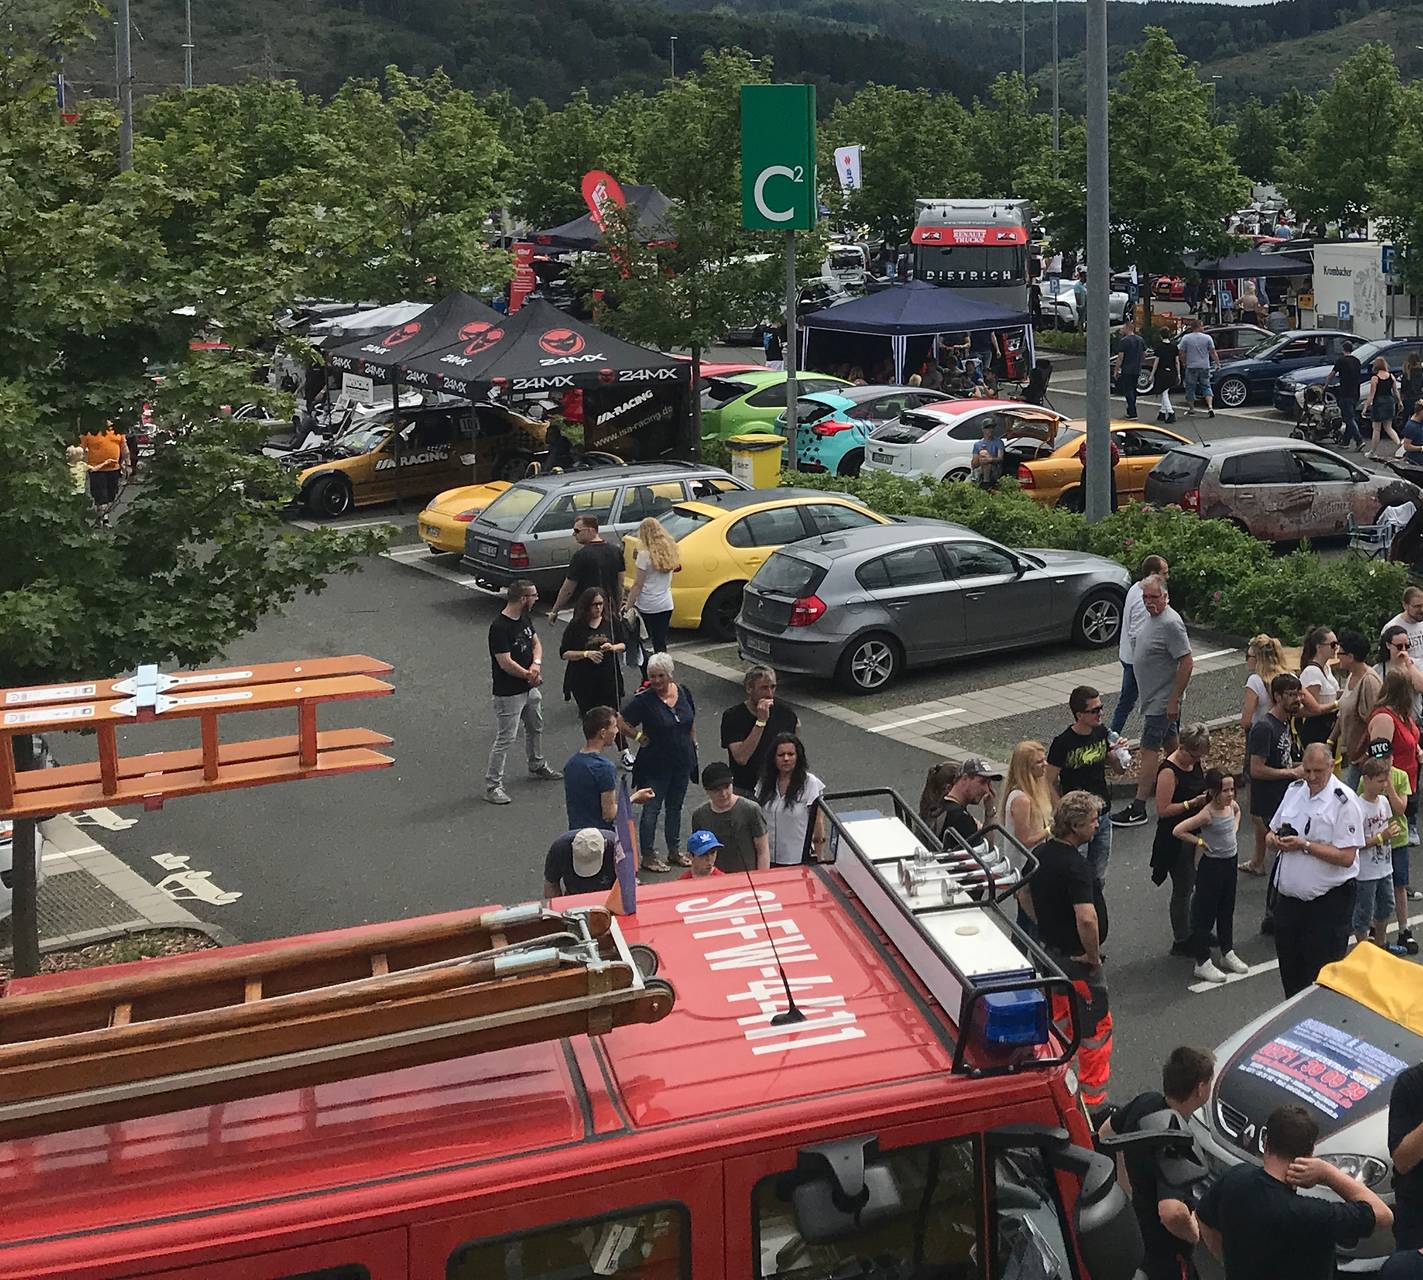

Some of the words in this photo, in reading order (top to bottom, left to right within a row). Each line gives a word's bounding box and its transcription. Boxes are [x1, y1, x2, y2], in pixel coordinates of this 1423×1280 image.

[927, 270, 1011, 281] DIETRICH
[1323, 265, 1352, 277] Krombacher
[332, 356, 352, 370] 24MX
[539, 353, 607, 367] 24MX
[364, 363, 386, 379] 24MX
[406, 370, 429, 384] 24MX
[619, 368, 678, 382] 24MX
[443, 377, 467, 394] 24MX
[512, 375, 575, 390] 24MX
[1371, 744, 1389, 754] NYC
[1339, 1082, 1369, 1101] 29
